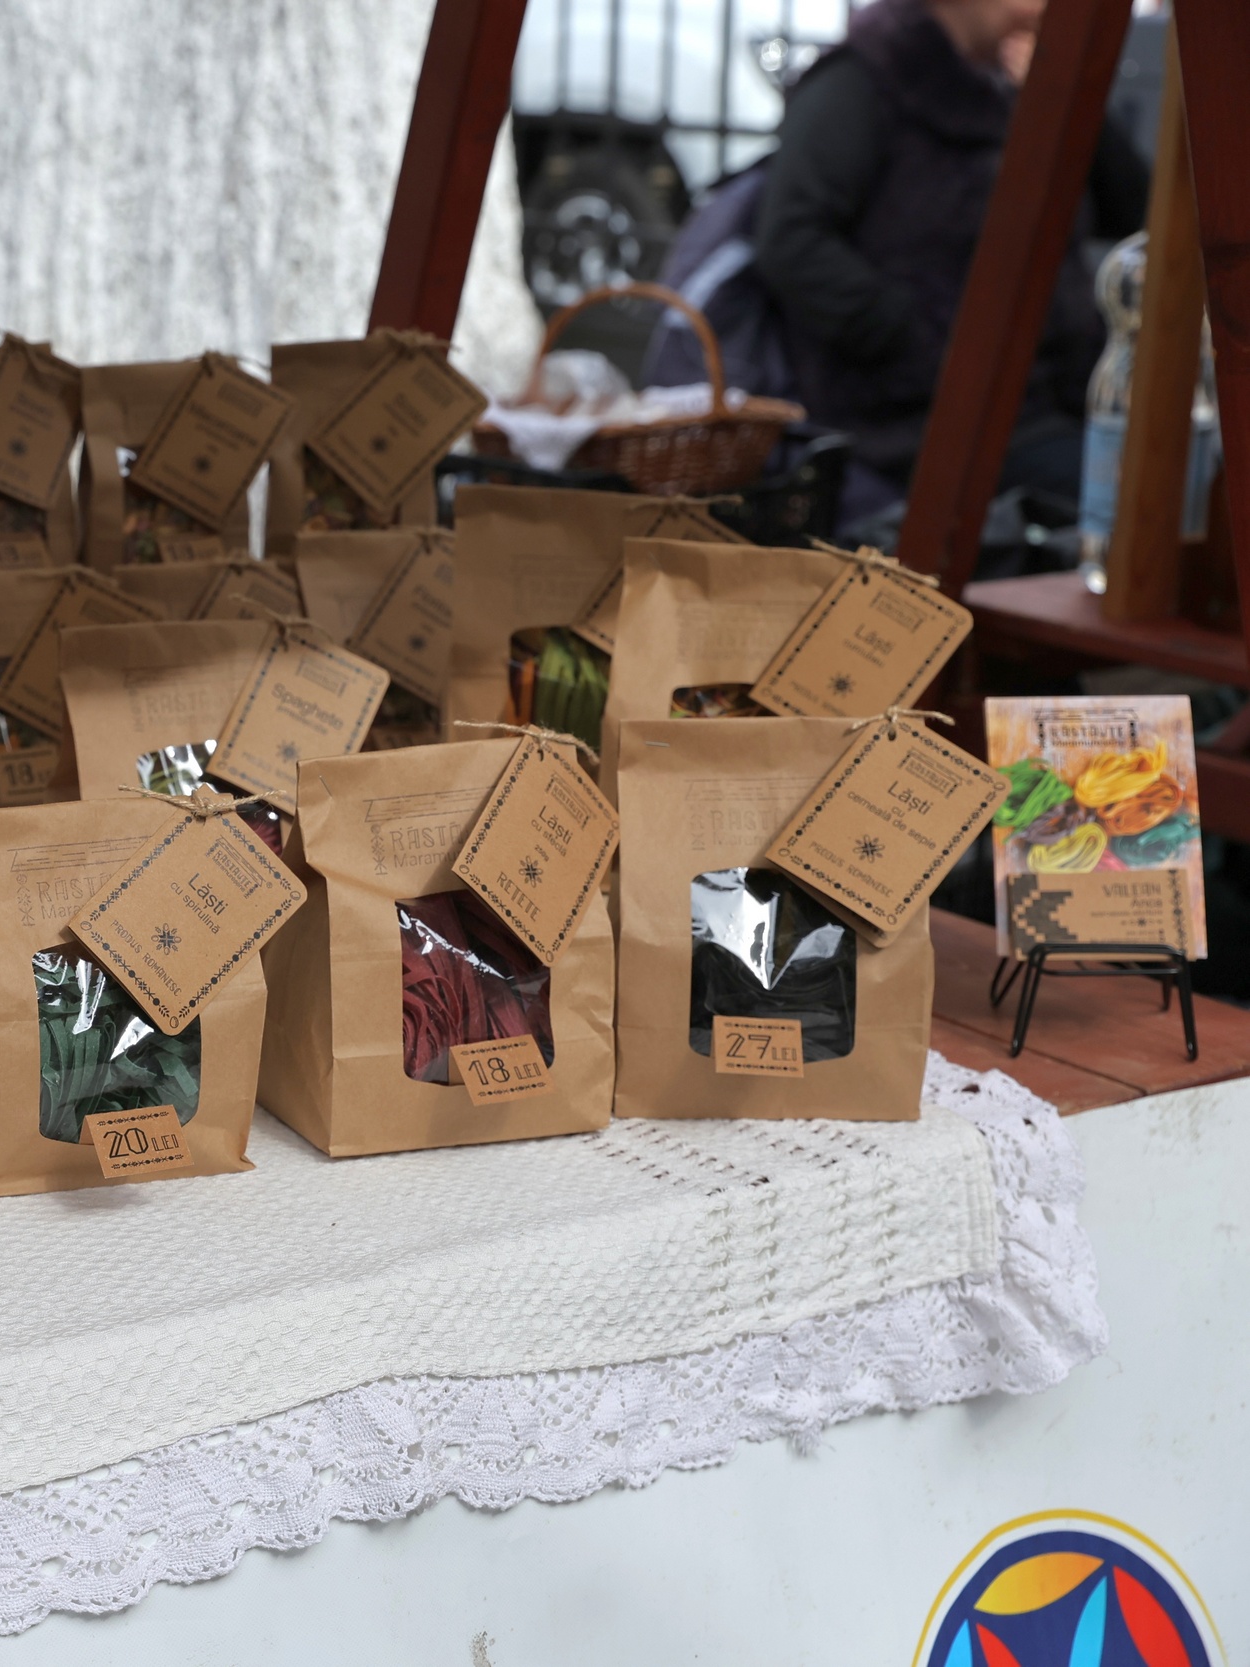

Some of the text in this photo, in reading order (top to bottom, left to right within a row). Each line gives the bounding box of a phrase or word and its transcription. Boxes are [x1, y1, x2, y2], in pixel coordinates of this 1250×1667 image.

[887, 780, 934, 816] Lăști
[891, 806, 905, 818] cu
[531, 819, 542, 832] cu
[539, 805, 573, 845] Lăști
[892, 818, 907, 831] de
[908, 828, 937, 851] sepie
[170, 882, 221, 934] cu spirulină
[188, 873, 229, 917] Lăști
[110, 919, 143, 954] PRODUS
[726, 1033, 797, 1061] 27 LEI
[469, 1057, 542, 1085] 18 LEI
[103, 1128, 179, 1158] 20 LEI
